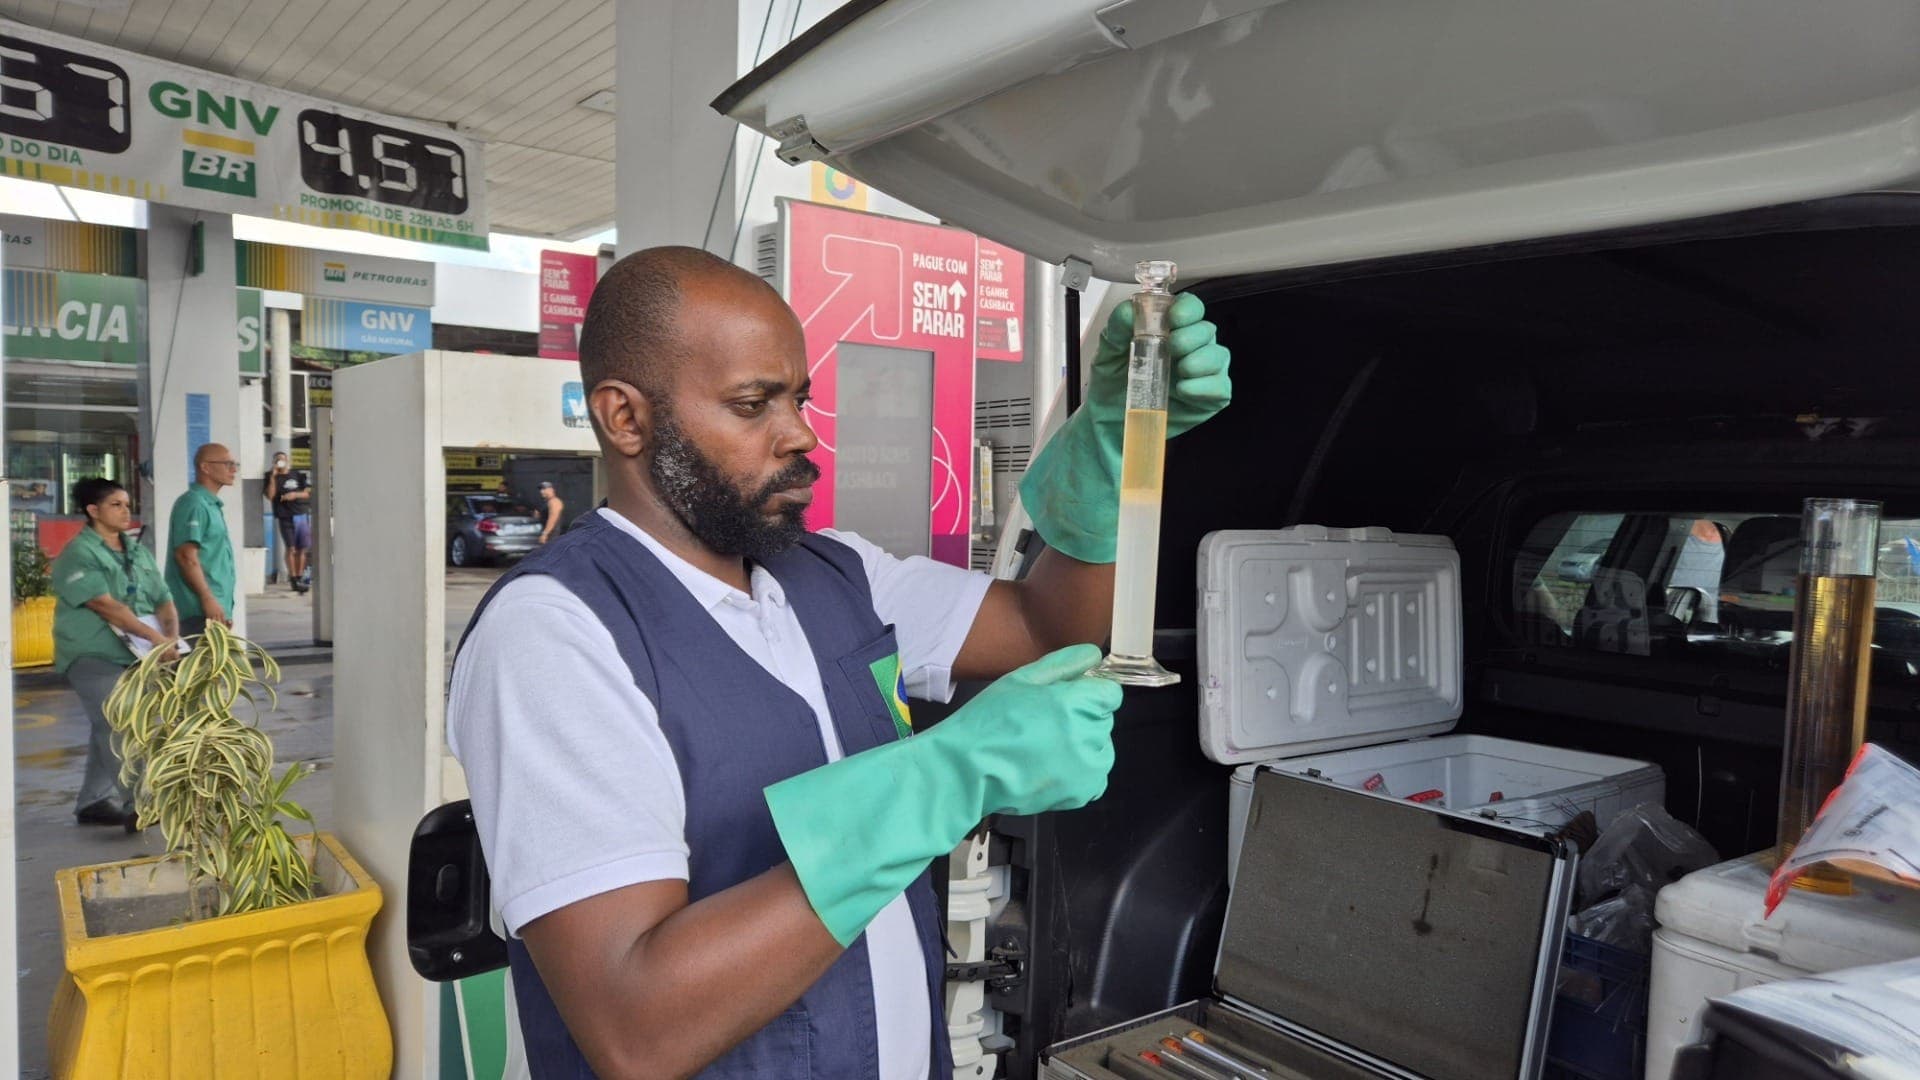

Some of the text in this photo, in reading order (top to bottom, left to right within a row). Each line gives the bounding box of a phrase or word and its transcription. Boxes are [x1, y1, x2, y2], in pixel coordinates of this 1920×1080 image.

[148, 81, 280, 136] GNV
[10, 139, 41, 157] DO
[47, 145, 83, 165] DIA
[302, 119, 465, 199] 4.57
[189, 153, 249, 182] BR
[384, 207, 403, 221] DE
[408, 212, 433, 226] 22H
[456, 219, 474, 232] 6H
[912, 252, 968, 275] PAGUE COM
[979, 259, 998, 272] SEM
[352, 271, 429, 286] PETROBRAS
[549, 293, 577, 305] GANHE
[912, 280, 948, 310] SEM
[986, 286, 1009, 299] GANHE
[543, 304, 585, 318] CASHBACK
[980, 298, 1015, 312] CASHBACK
[361, 309, 415, 332] GNV
[912, 307, 965, 338] PARAR
